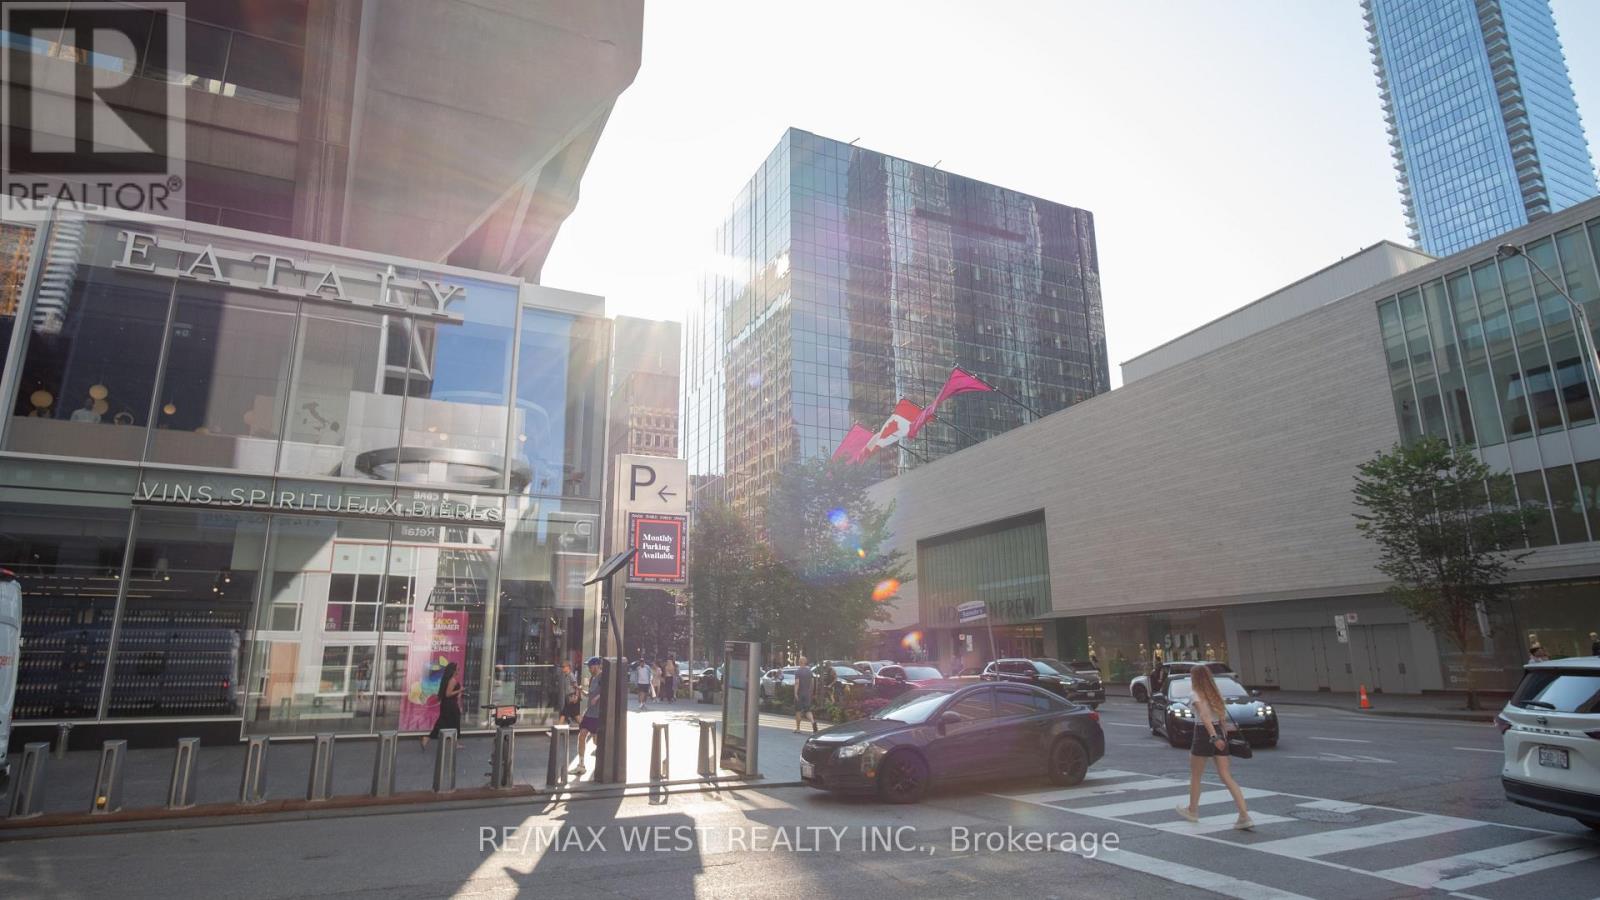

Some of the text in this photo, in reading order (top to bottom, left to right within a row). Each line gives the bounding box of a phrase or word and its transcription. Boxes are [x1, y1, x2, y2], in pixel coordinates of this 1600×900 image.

[114, 229, 465, 317] EATALY
[630, 464, 657, 502] P
[141, 480, 213, 504] VINS
[229, 486, 398, 517] SPIRITUEUX
[642, 533, 673, 543] Monthly
[642, 543, 672, 553] Parking
[641, 552, 675, 561] Available
